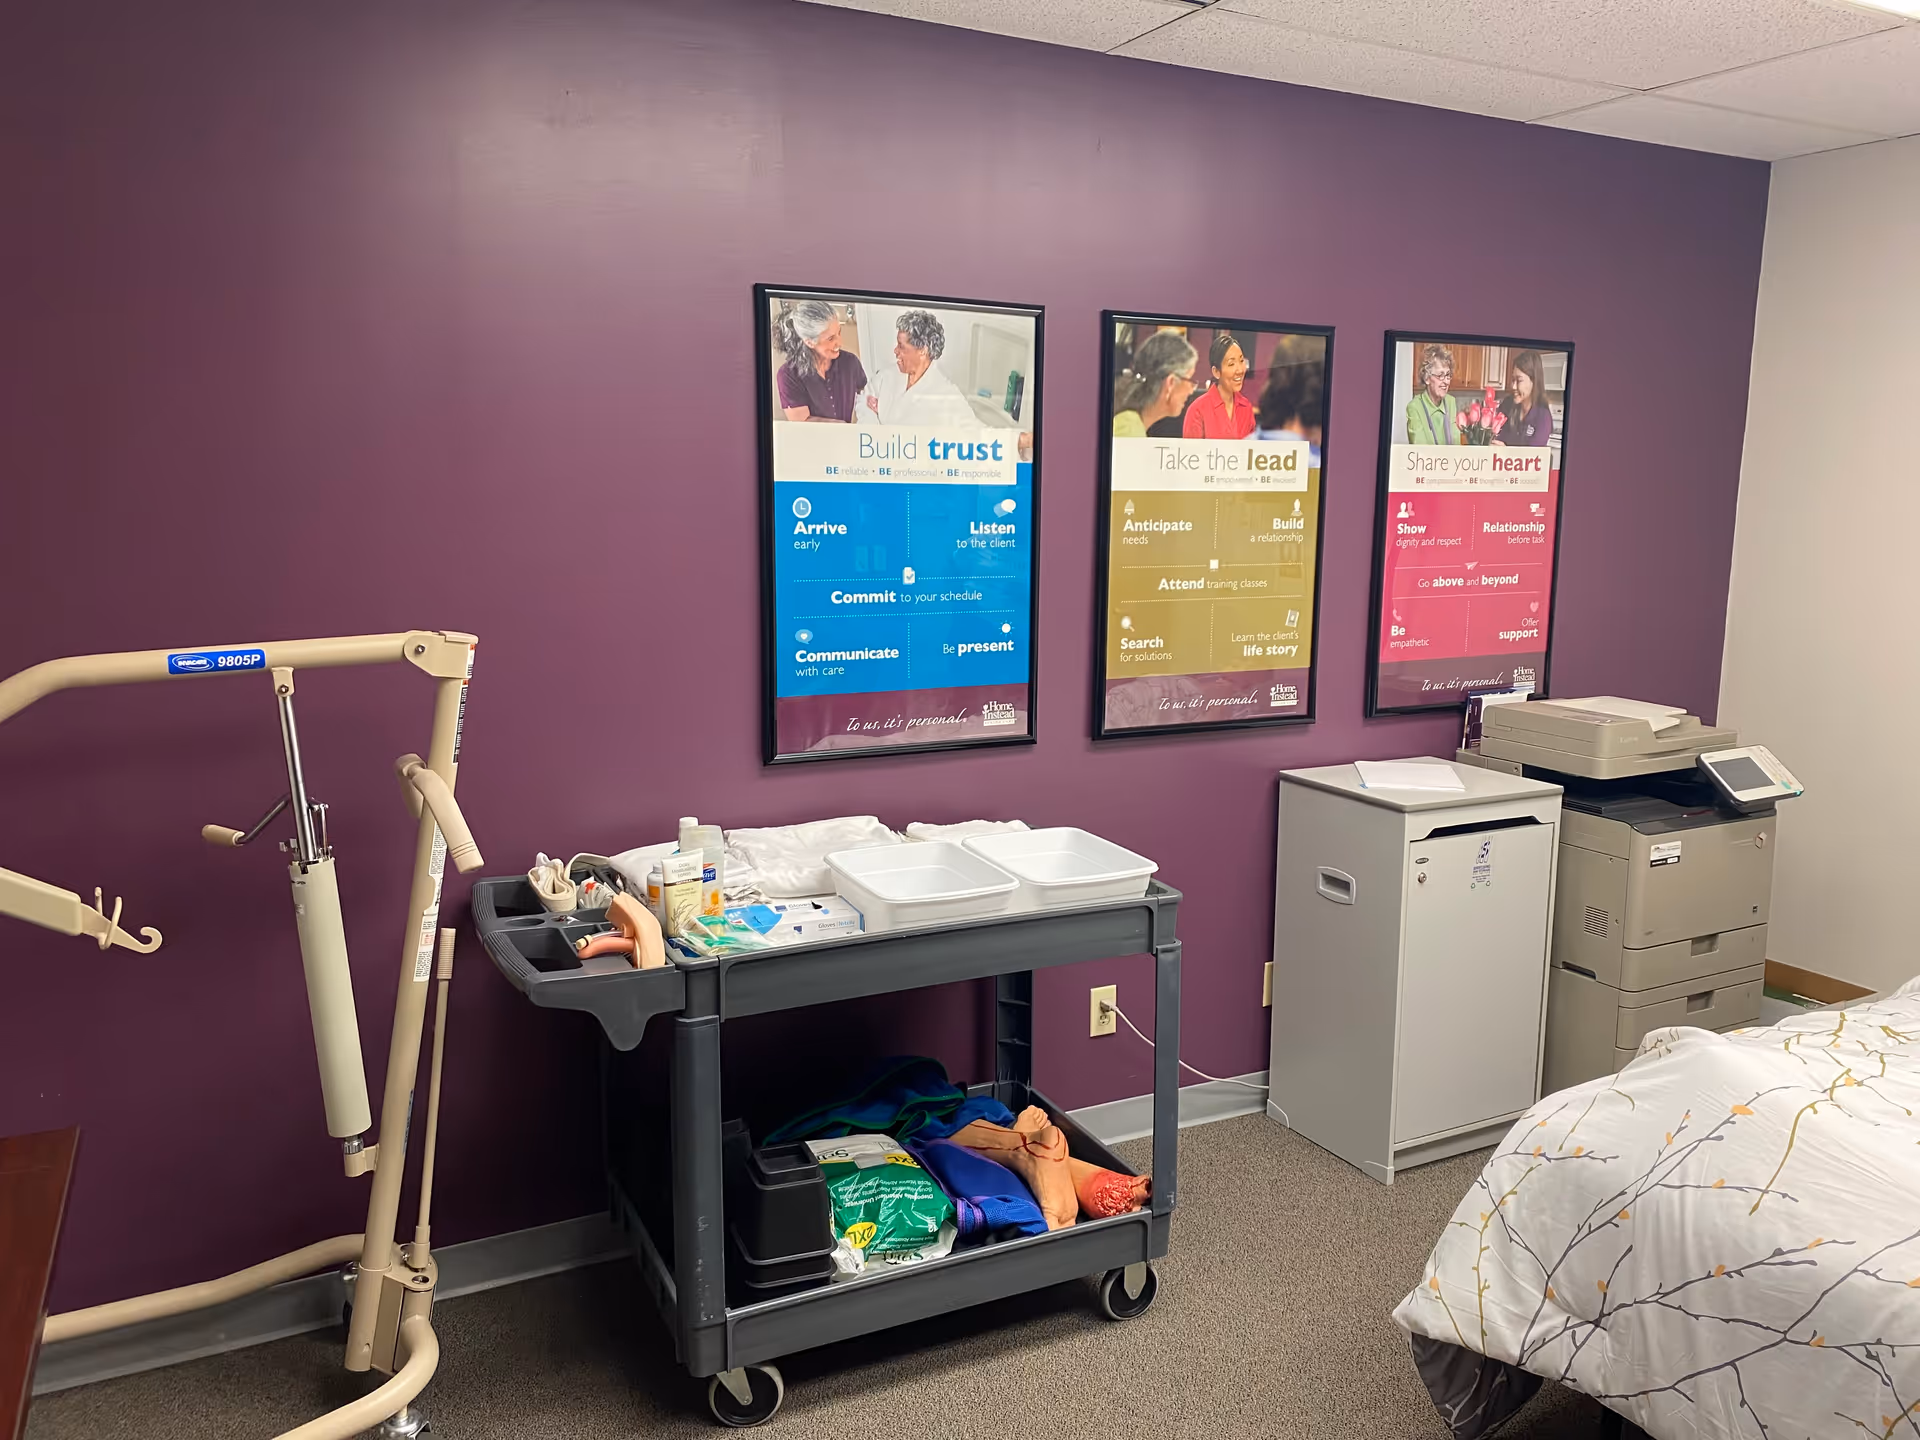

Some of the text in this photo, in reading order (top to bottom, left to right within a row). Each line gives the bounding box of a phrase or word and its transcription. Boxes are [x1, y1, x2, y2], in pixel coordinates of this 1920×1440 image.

[859, 433, 1003, 461] Build trust
[1154, 446, 1297, 471] Take the lead
[1407, 451, 1542, 477] Share your heart
[826, 466, 1002, 480] BE reliable BE professional BE responsible
[1260, 476, 1271, 484] BE
[794, 521, 847, 535] Arrive
[970, 521, 1016, 534] Listen
[1123, 519, 1192, 534] Anticipate
[1272, 518, 1304, 530] Build
[1397, 523, 1427, 534] Show
[1483, 521, 1546, 534] Relationship
[794, 538, 820, 552] early
[956, 538, 1016, 548] to the client
[1123, 534, 1148, 545] needs
[1258, 533, 1304, 544] relationship
[1396, 536, 1462, 549] dignity and respect
[1508, 535, 1544, 544] before task
[1158, 578, 1268, 590] Attend training classes
[1418, 574, 1519, 588] Go above and beyond
[830, 590, 982, 605] Commit to your schedule
[1521, 617, 1539, 627] Offer
[1231, 630, 1299, 642] Learn the client's
[1391, 625, 1406, 636] Be
[1499, 628, 1538, 642] support
[942, 640, 1014, 657] Be present
[1120, 636, 1164, 650] Search
[1390, 638, 1430, 650] empathetic
[795, 648, 900, 663] Communicate
[1120, 650, 1172, 663] for solutions
[1243, 644, 1298, 657] life story
[218, 654, 260, 668] 9805P
[795, 666, 845, 677] with care
[1518, 666, 1535, 675] Home
[1276, 684, 1297, 693] Home
[1421, 679, 1432, 691] To
[1446, 677, 1459, 689] it's
[1271, 690, 1298, 701] Instead
[989, 700, 1014, 711] Home
[1158, 697, 1171, 710] To
[1188, 696, 1204, 708] it's
[846, 717, 860, 732] To
[884, 714, 904, 729] it's
[905, 708, 968, 731] personal.
[984, 708, 1015, 720] Instead
[847, 1225, 874, 1245] 2XL
